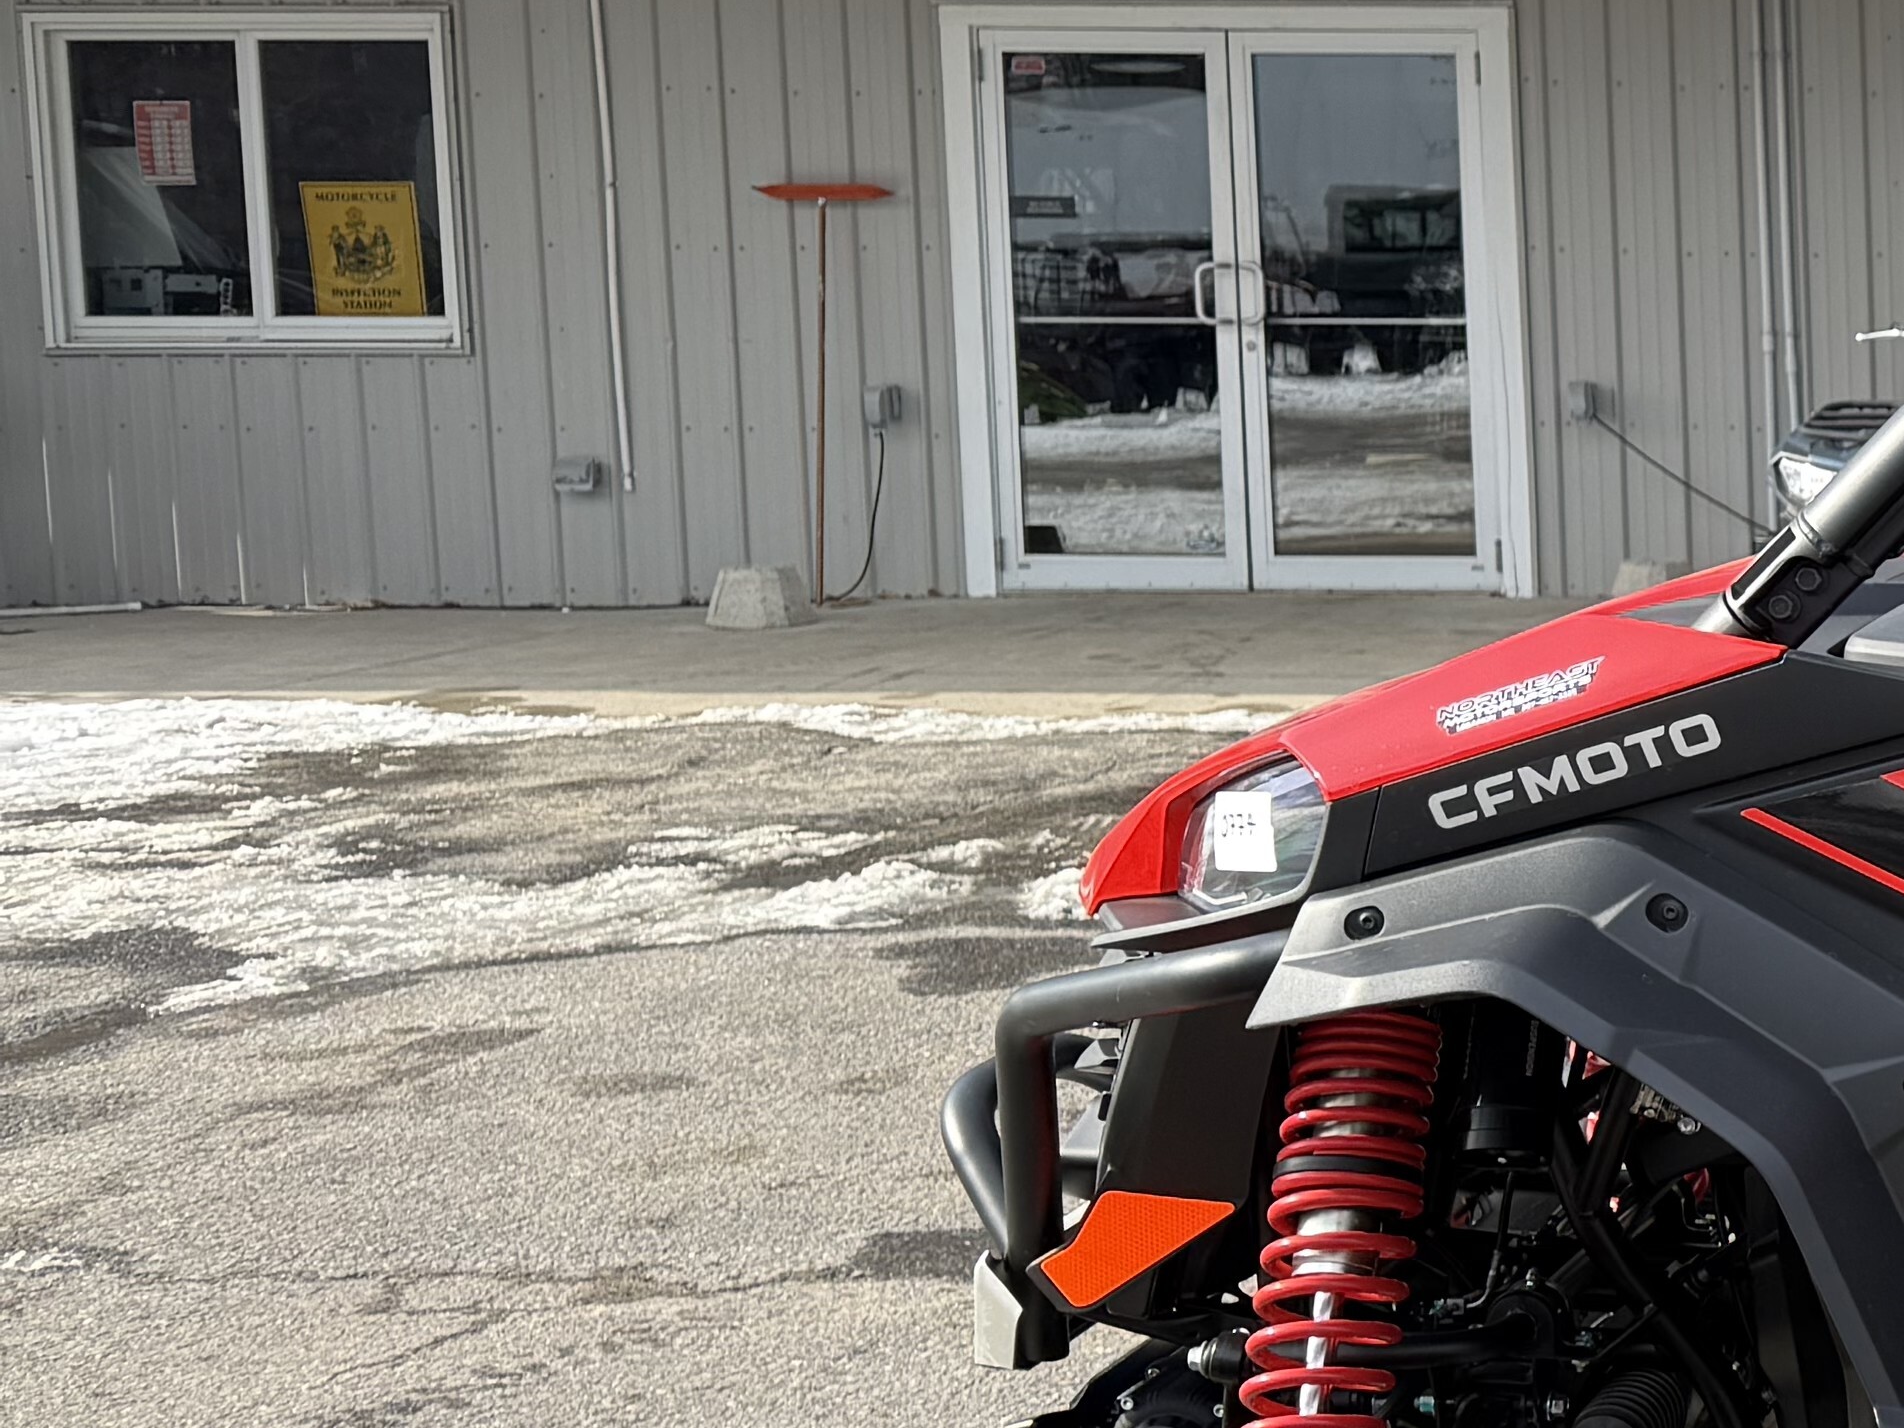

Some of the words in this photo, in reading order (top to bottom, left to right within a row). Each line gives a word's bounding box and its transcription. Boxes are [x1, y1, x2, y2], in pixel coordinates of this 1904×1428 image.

[315, 190, 399, 204] MOTORCYCLE
[342, 299, 393, 310] STATION
[1437, 656, 1605, 722] NORTHEAST
[1443, 672, 1593, 728] MOTORSPORTS
[1428, 713, 1722, 830] CFMOTO
